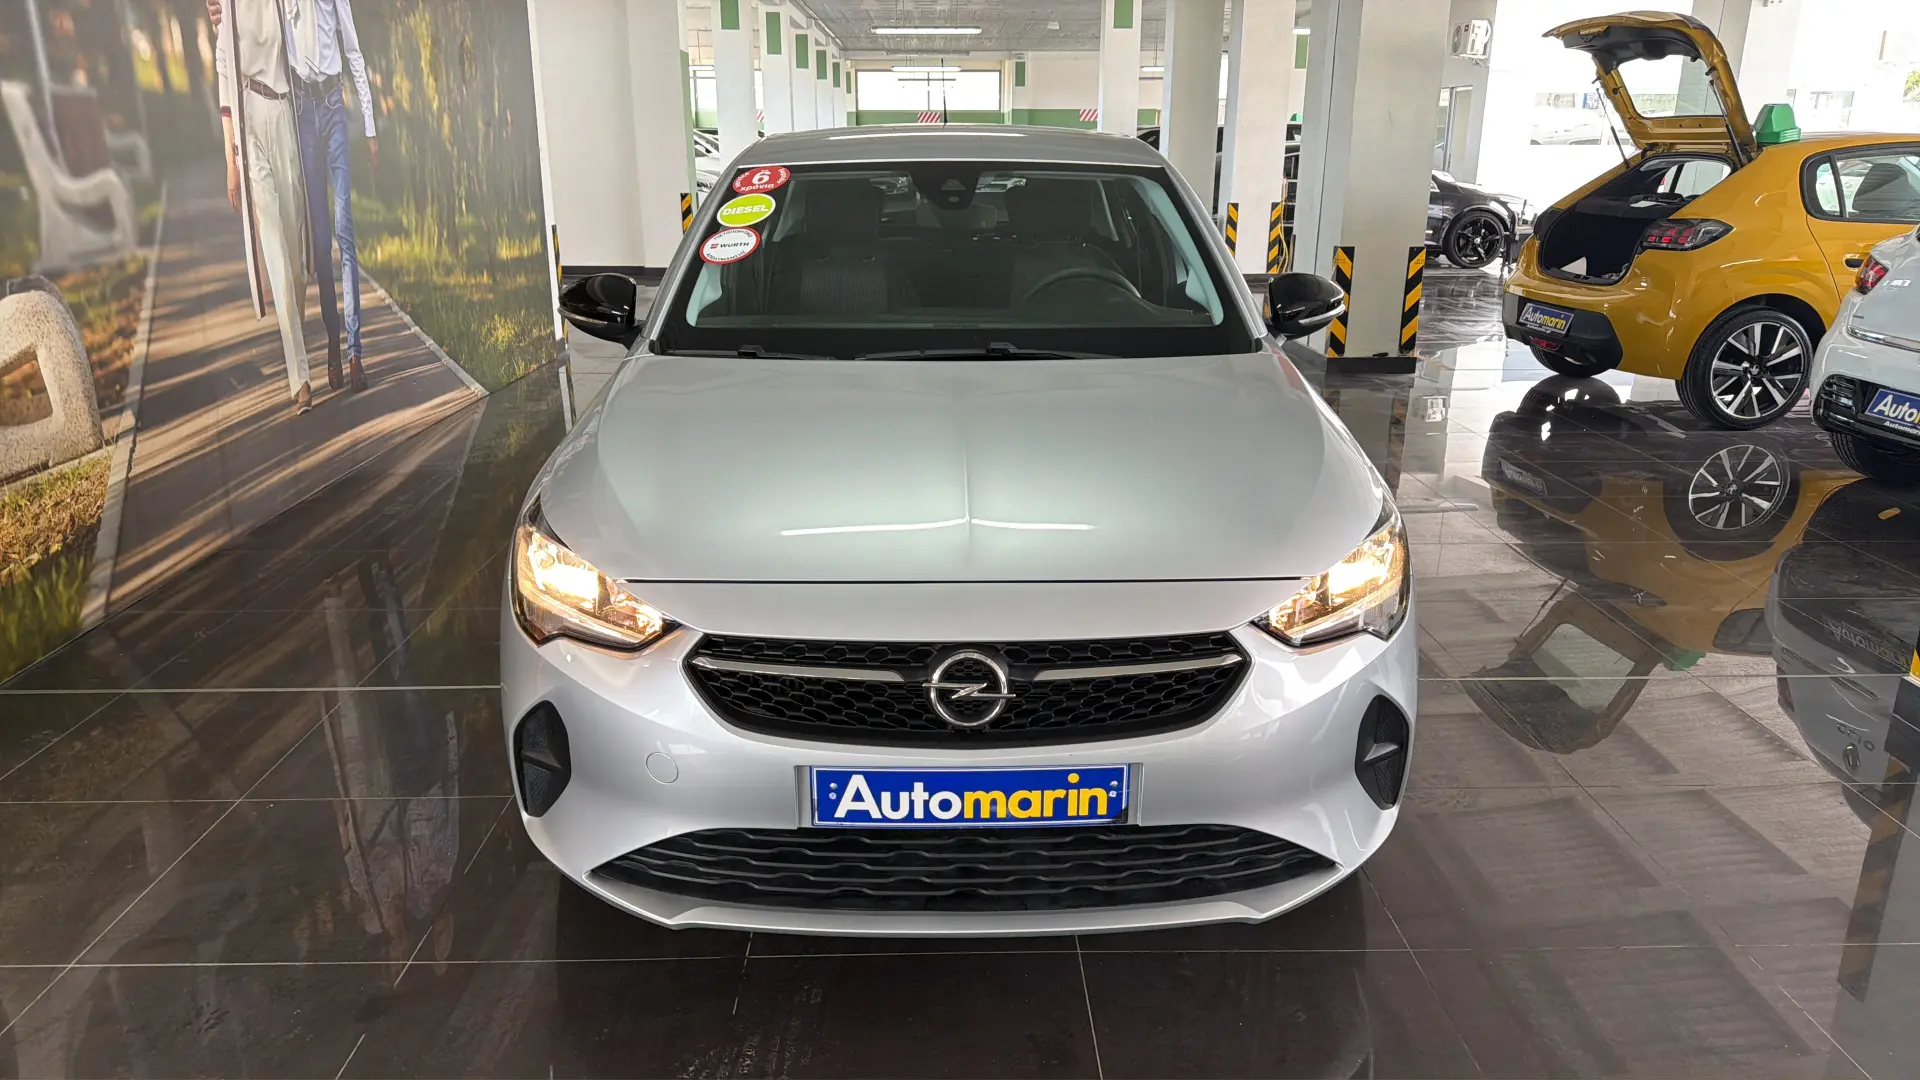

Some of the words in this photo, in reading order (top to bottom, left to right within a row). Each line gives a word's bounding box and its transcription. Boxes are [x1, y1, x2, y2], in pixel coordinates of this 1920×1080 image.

[752, 171, 771, 185] 6
[722, 204, 768, 215] DIESEL
[1523, 306, 1567, 329] Automarin
[834, 773, 1108, 820] Automarin
